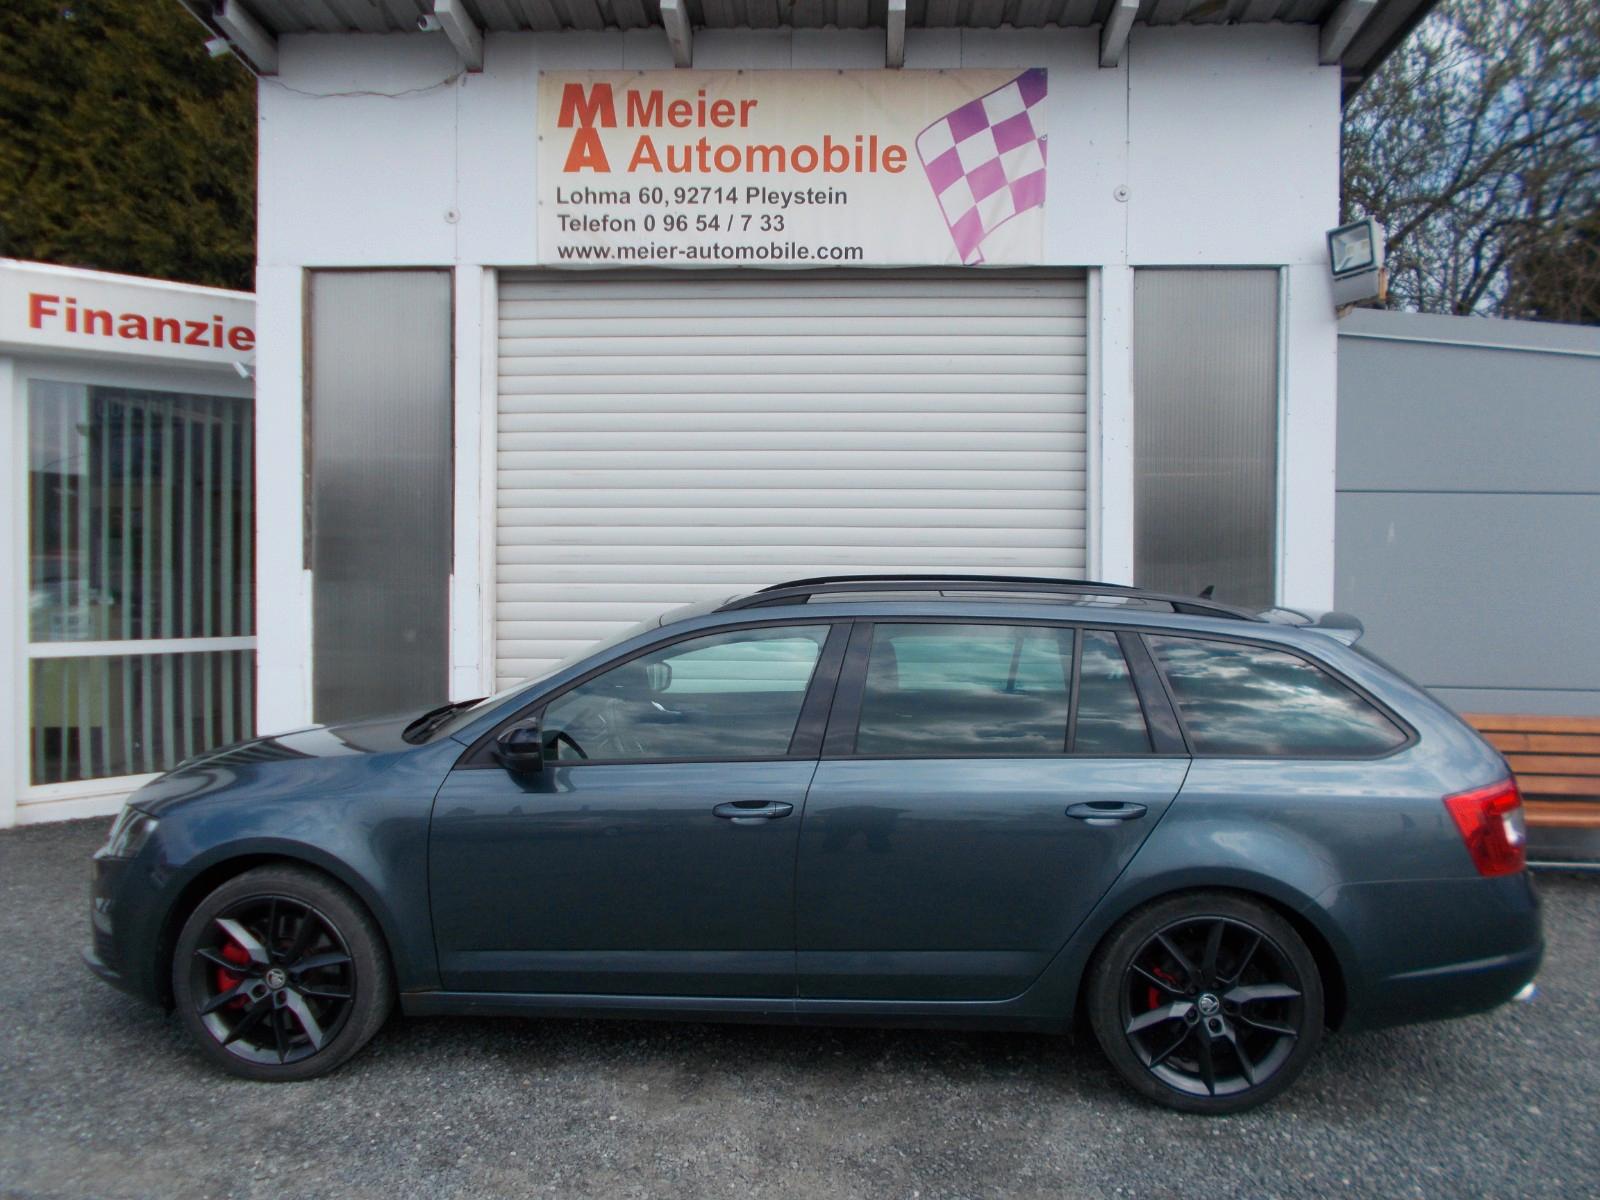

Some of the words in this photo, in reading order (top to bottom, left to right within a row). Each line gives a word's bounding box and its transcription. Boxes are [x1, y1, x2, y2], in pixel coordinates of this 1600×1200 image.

[626, 89, 758, 128] Meier
[627, 134, 908, 174] Automobile
[556, 186, 631, 204] Lohma
[746, 186, 848, 209] Pleystein
[557, 214, 636, 232] Telefon
[643, 214, 656, 232] 0
[663, 214, 688, 232] 96
[696, 214, 721, 232] 54
[741, 214, 752, 232] 7
[760, 214, 786, 232] 33
[557, 242, 864, 260] www.meier-automobile.com
[28, 292, 256, 351] Finanzie
